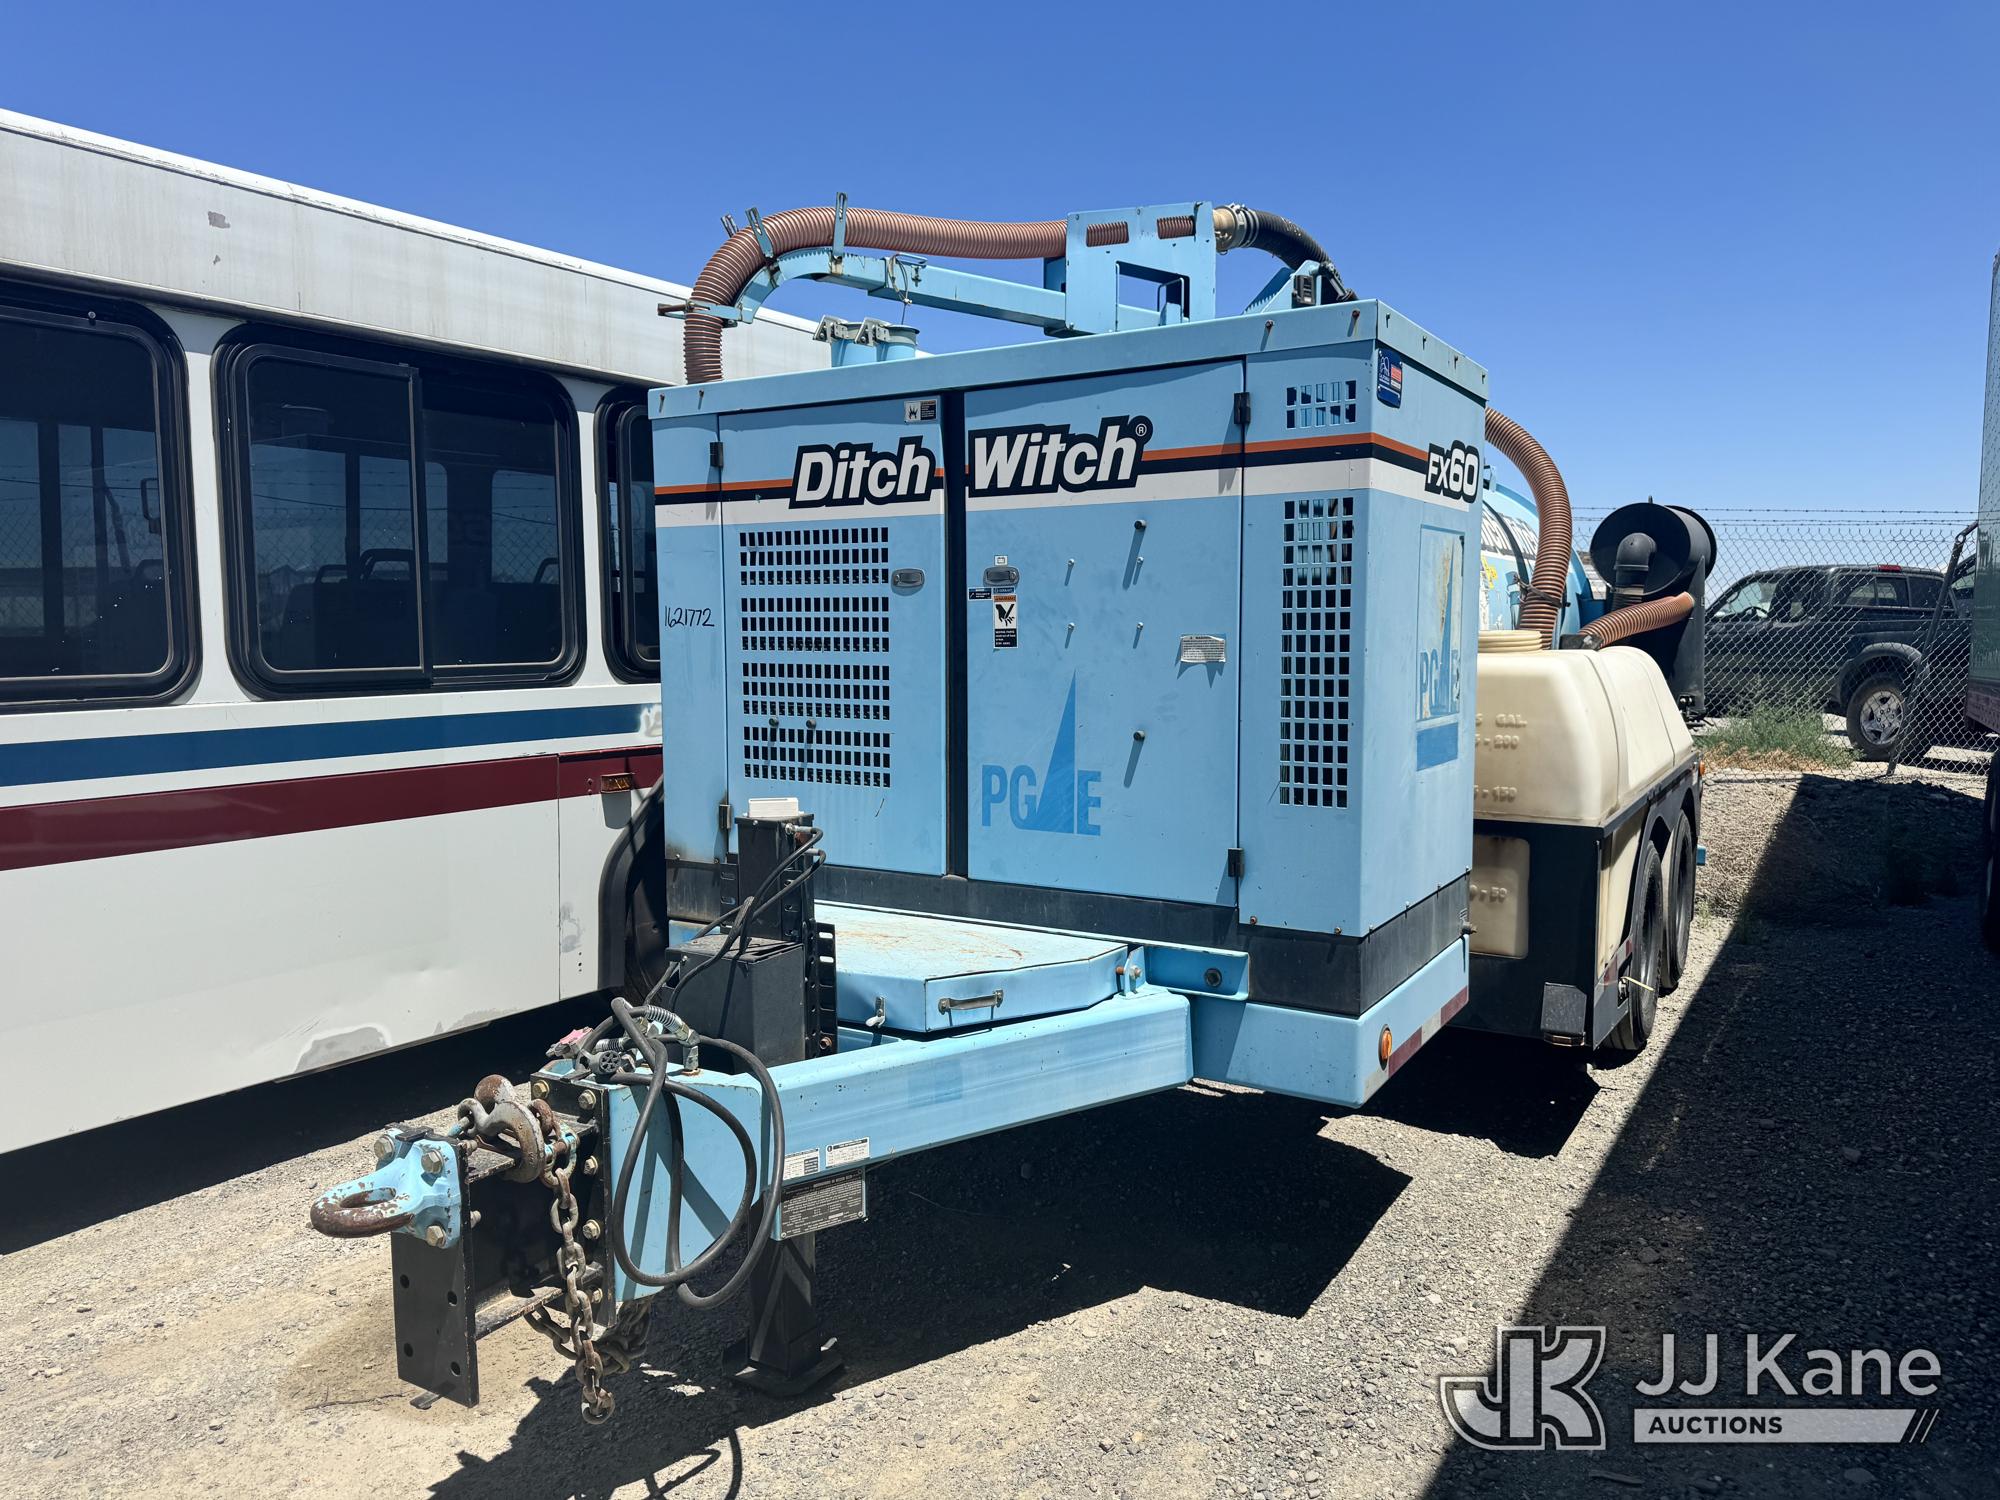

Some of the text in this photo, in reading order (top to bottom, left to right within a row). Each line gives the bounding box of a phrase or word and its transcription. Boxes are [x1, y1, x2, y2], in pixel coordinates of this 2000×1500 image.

[796, 444, 930, 501] Ditch
[1427, 448, 1478, 497] FX60
[664, 605, 715, 627] 1621772
